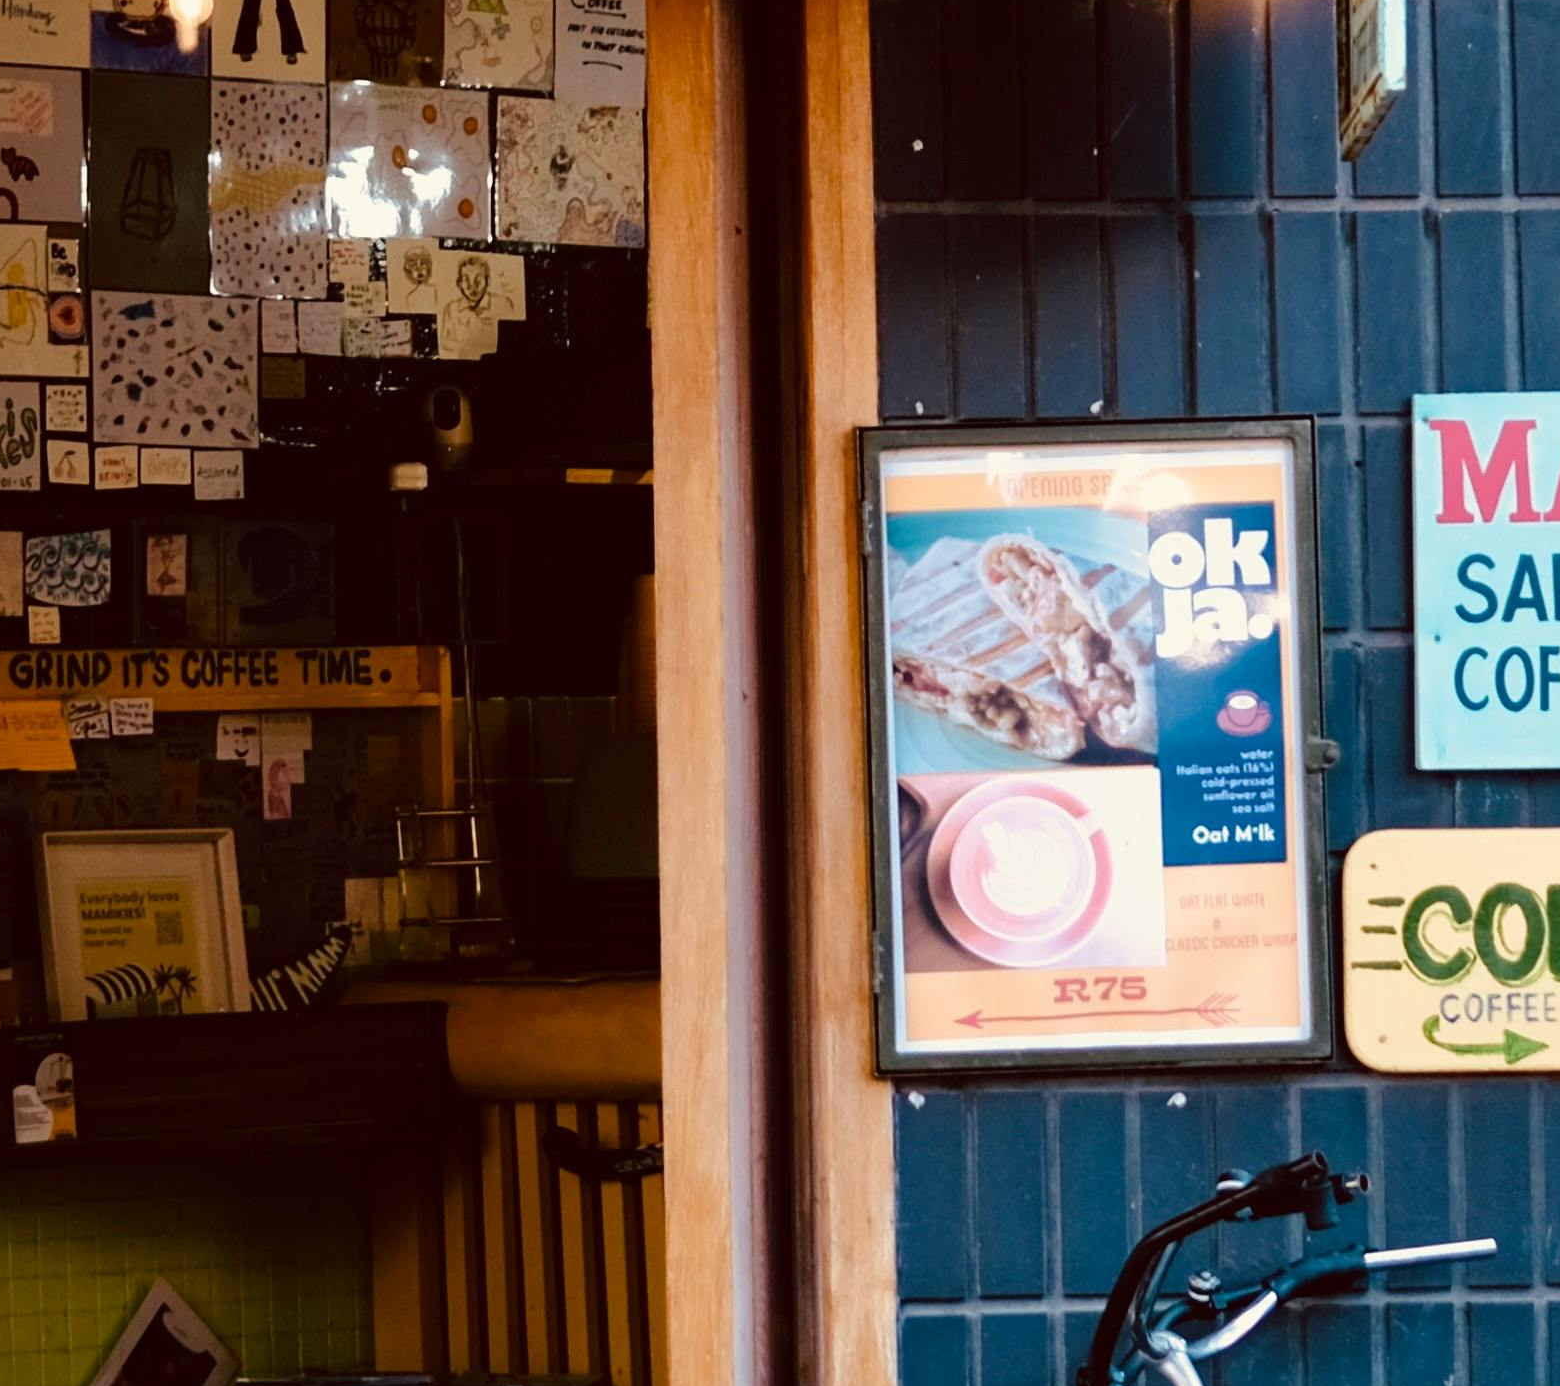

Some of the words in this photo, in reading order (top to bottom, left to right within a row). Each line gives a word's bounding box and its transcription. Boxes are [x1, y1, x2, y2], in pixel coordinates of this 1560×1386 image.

[1148, 518, 1271, 588] ok
[9, 651, 112, 688] GRIND
[123, 651, 170, 687] IT'S
[181, 649, 278, 688] COFFEE
[1216, 764, 1240, 774] oats
[1201, 775, 1274, 789] cold-pressed
[1203, 791, 1256, 802] sunflower
[1260, 789, 1275, 799] oil
[1232, 804, 1252, 813] sea
[1192, 824, 1229, 844] Oat
[80, 892, 144, 906] Everybody
[1166, 936, 1209, 952] CLASSIC
[1213, 934, 1259, 950] CHICKEN
[1053, 974, 1148, 1004] R75
[1439, 990, 1557, 1024] COFFEE
